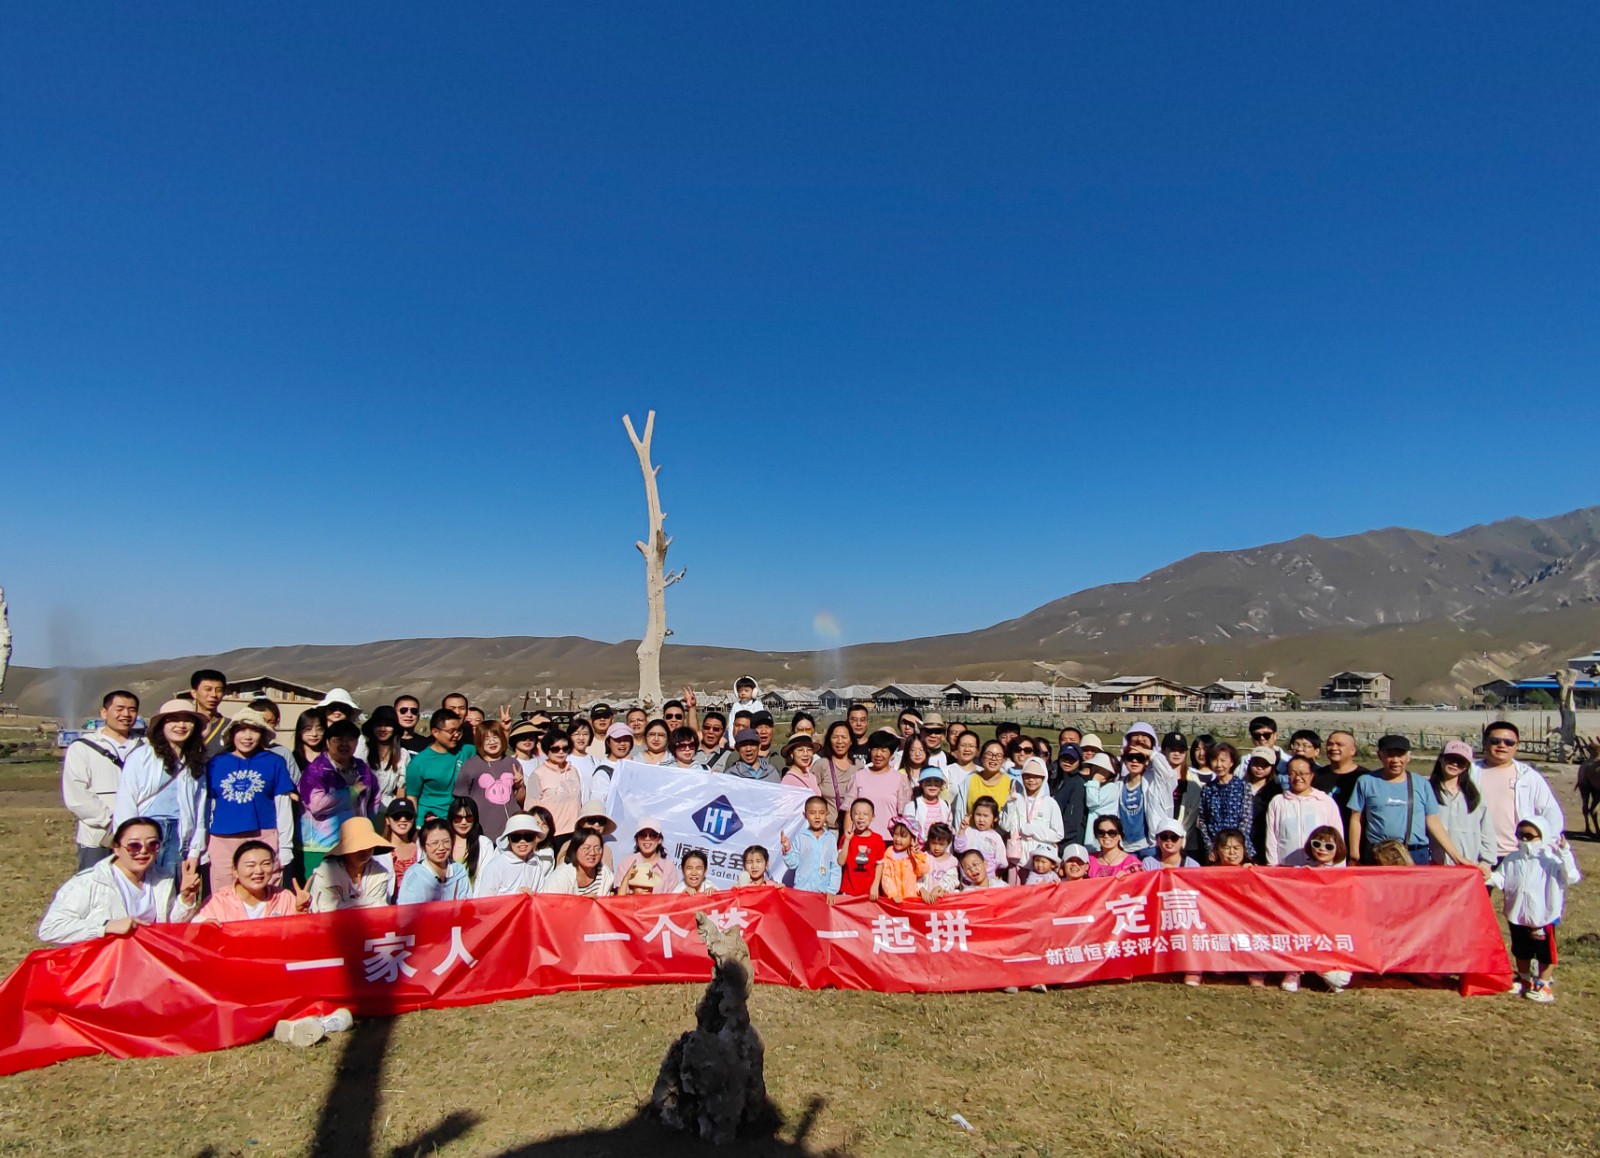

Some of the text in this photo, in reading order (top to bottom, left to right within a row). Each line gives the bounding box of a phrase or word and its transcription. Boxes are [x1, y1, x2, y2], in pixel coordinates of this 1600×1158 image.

[703, 806, 733, 836] HT
[285, 926, 479, 983] 一家人
[816, 910, 972, 955] 一起拼
[1052, 888, 1206, 936] 一定赢
[1191, 933, 1355, 952] 新疆恒泰职评公司
